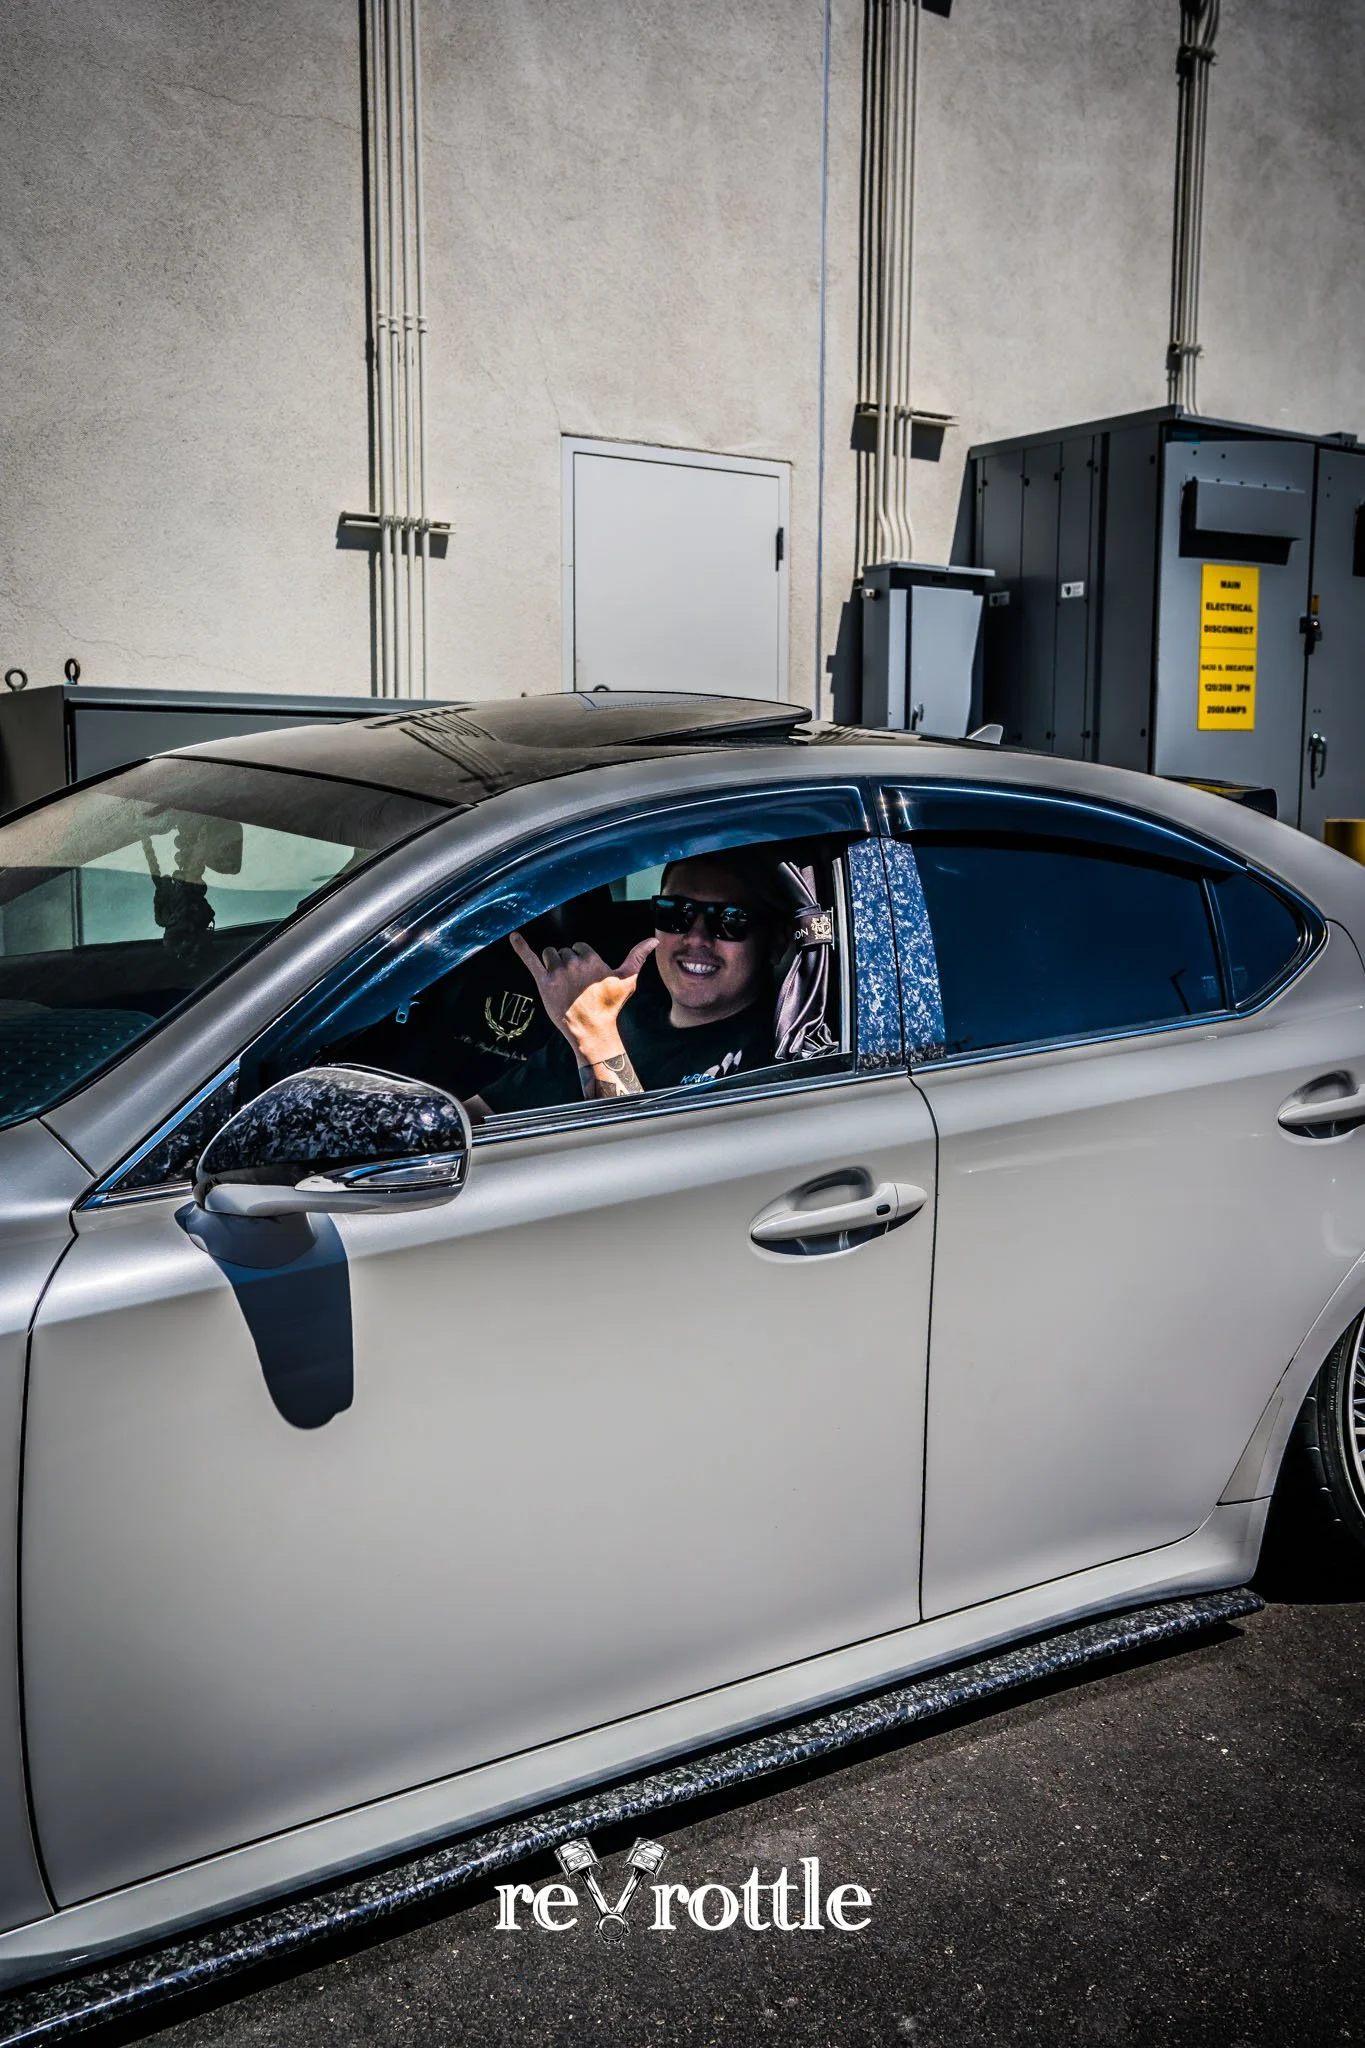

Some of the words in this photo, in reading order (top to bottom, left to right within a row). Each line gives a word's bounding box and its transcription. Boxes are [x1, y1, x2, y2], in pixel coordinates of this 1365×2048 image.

[1220, 580, 1241, 590] MAIN
[1205, 602, 1253, 613] ELECTRICAL
[1203, 625, 1254, 635] DISCONNECT
[1206, 705, 1225, 714] 2000
[1225, 705, 1247, 714] AMPS
